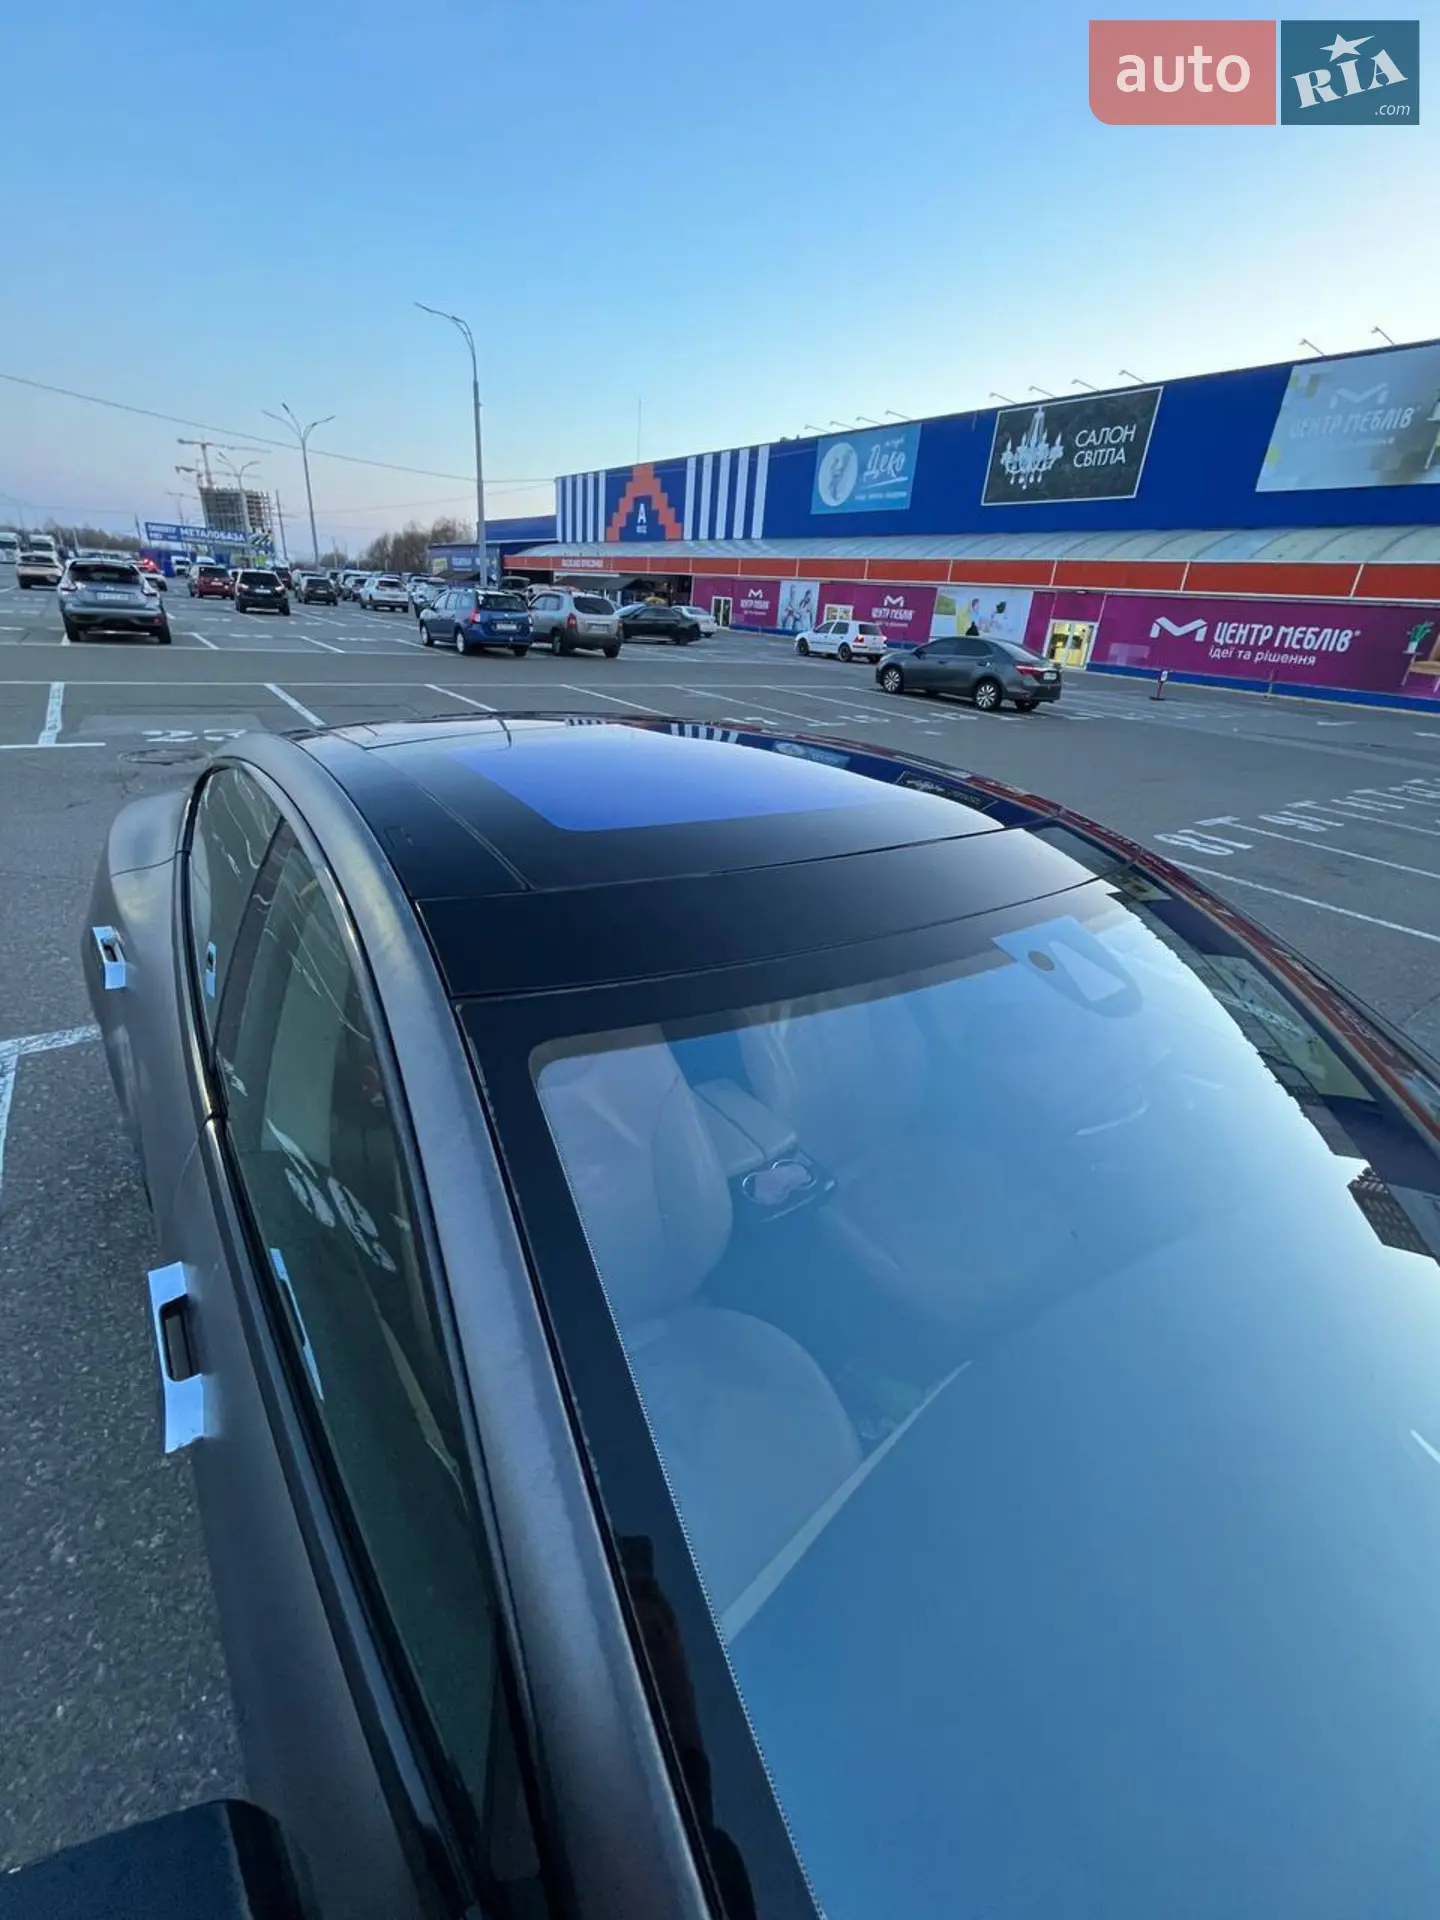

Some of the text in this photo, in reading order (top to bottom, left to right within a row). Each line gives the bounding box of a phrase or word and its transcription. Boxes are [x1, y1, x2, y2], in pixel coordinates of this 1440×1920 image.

[1075, 424, 1136, 447] САЛОН
[1290, 407, 1414, 438] ЦЕНТР МЕБЛІВ
[863, 444, 906, 482] Деко
[1073, 447, 1126, 468] СВІТЛА
[1214, 622, 1274, 646] ЦЕНТР
[1274, 625, 1354, 652] МЕБЛІВ
[1209, 646, 1317, 667] ідеї та рішення
